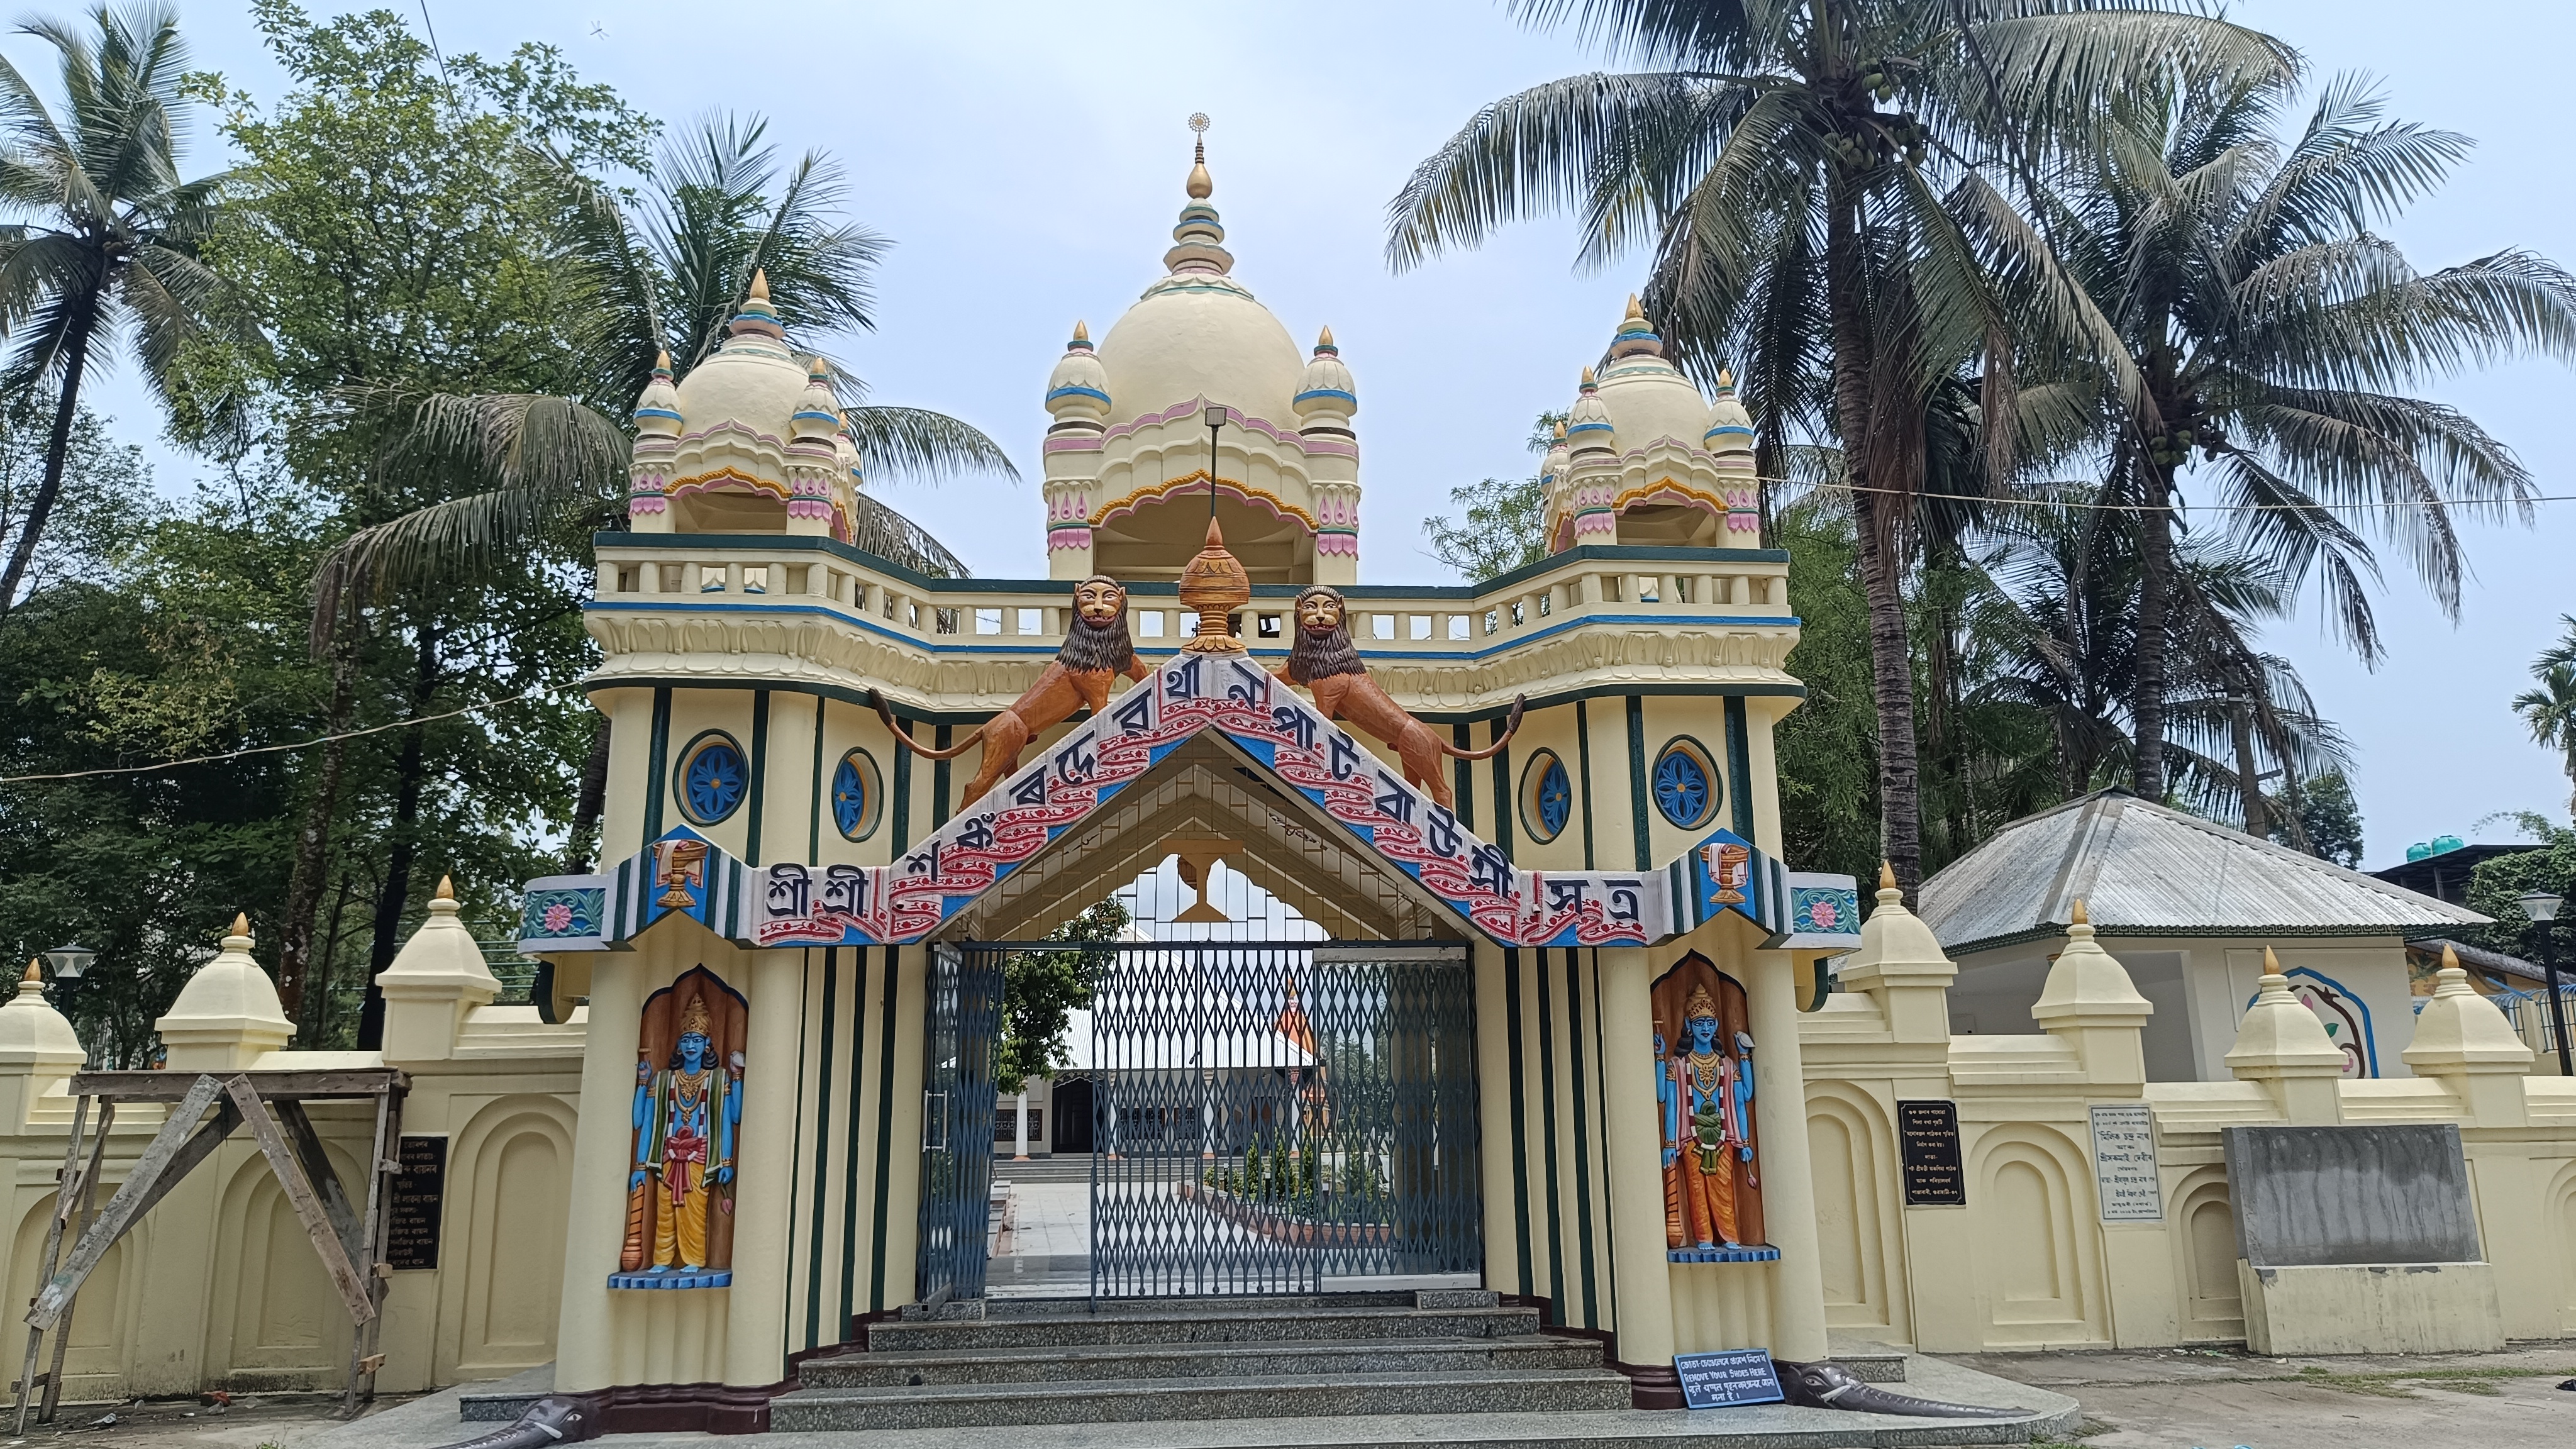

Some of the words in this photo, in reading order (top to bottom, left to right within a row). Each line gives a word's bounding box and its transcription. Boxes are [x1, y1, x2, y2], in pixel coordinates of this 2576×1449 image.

[1165, 655, 1265, 714] থান
[1684, 1372, 1709, 1382] REMOVE
[1709, 1370, 1728, 1379] YOUR
[1729, 1368, 1749, 1377] SHOES
[1749, 1367, 1767, 1376] HERE
